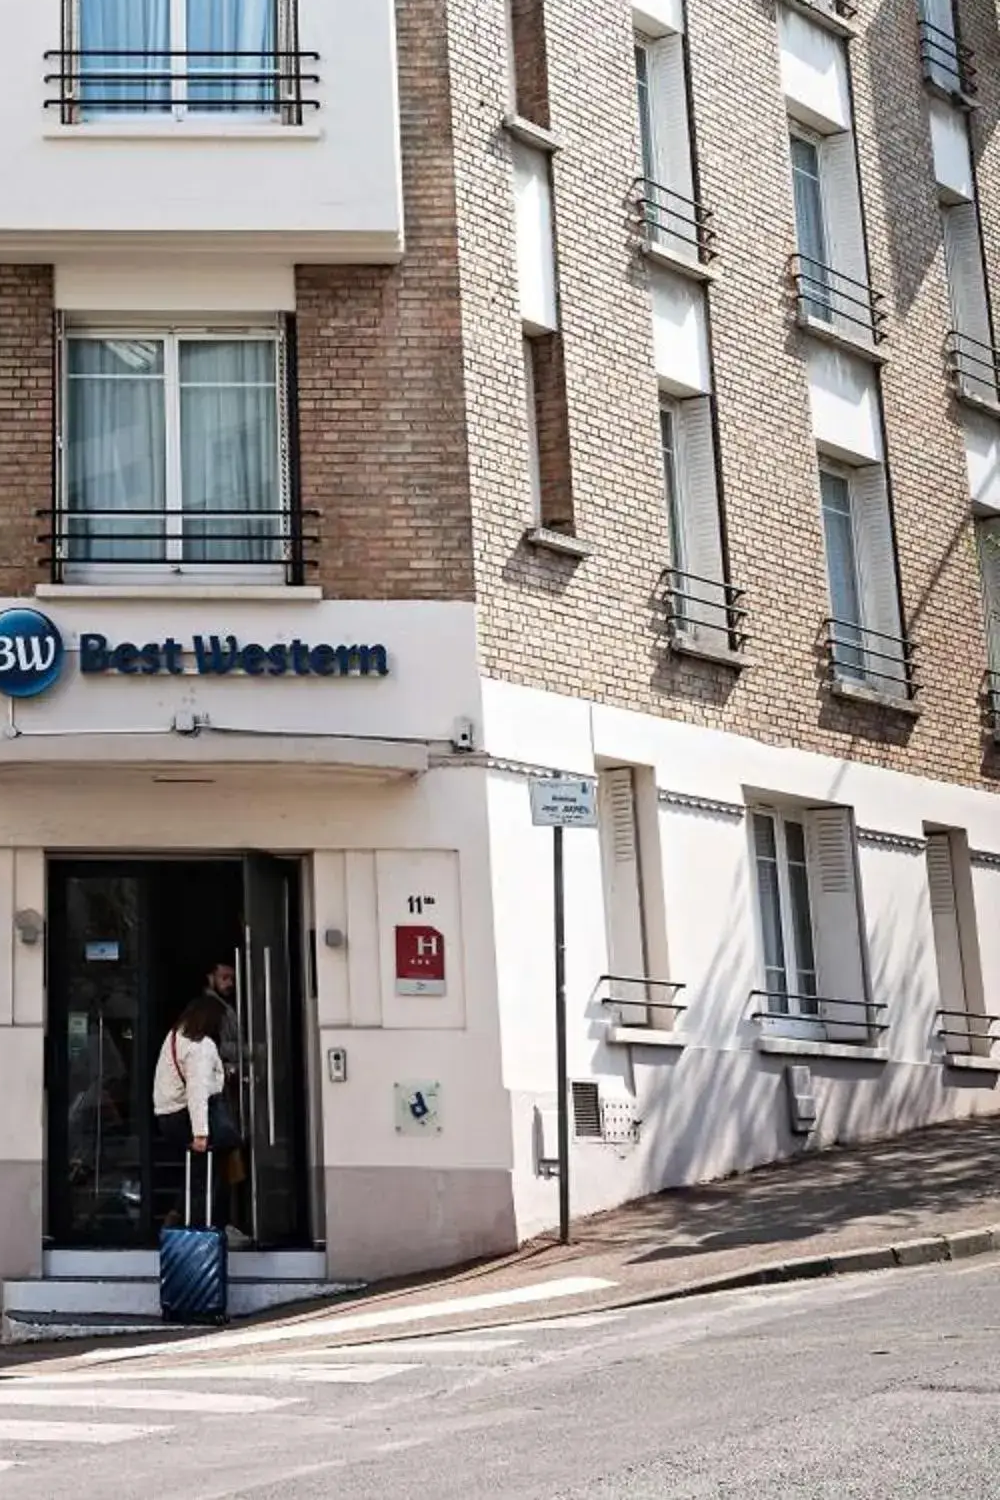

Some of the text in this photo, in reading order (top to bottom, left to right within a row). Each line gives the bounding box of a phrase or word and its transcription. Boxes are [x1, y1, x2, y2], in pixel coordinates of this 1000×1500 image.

[79, 633, 390, 676] Best Western
[417, 935, 438, 956] H
